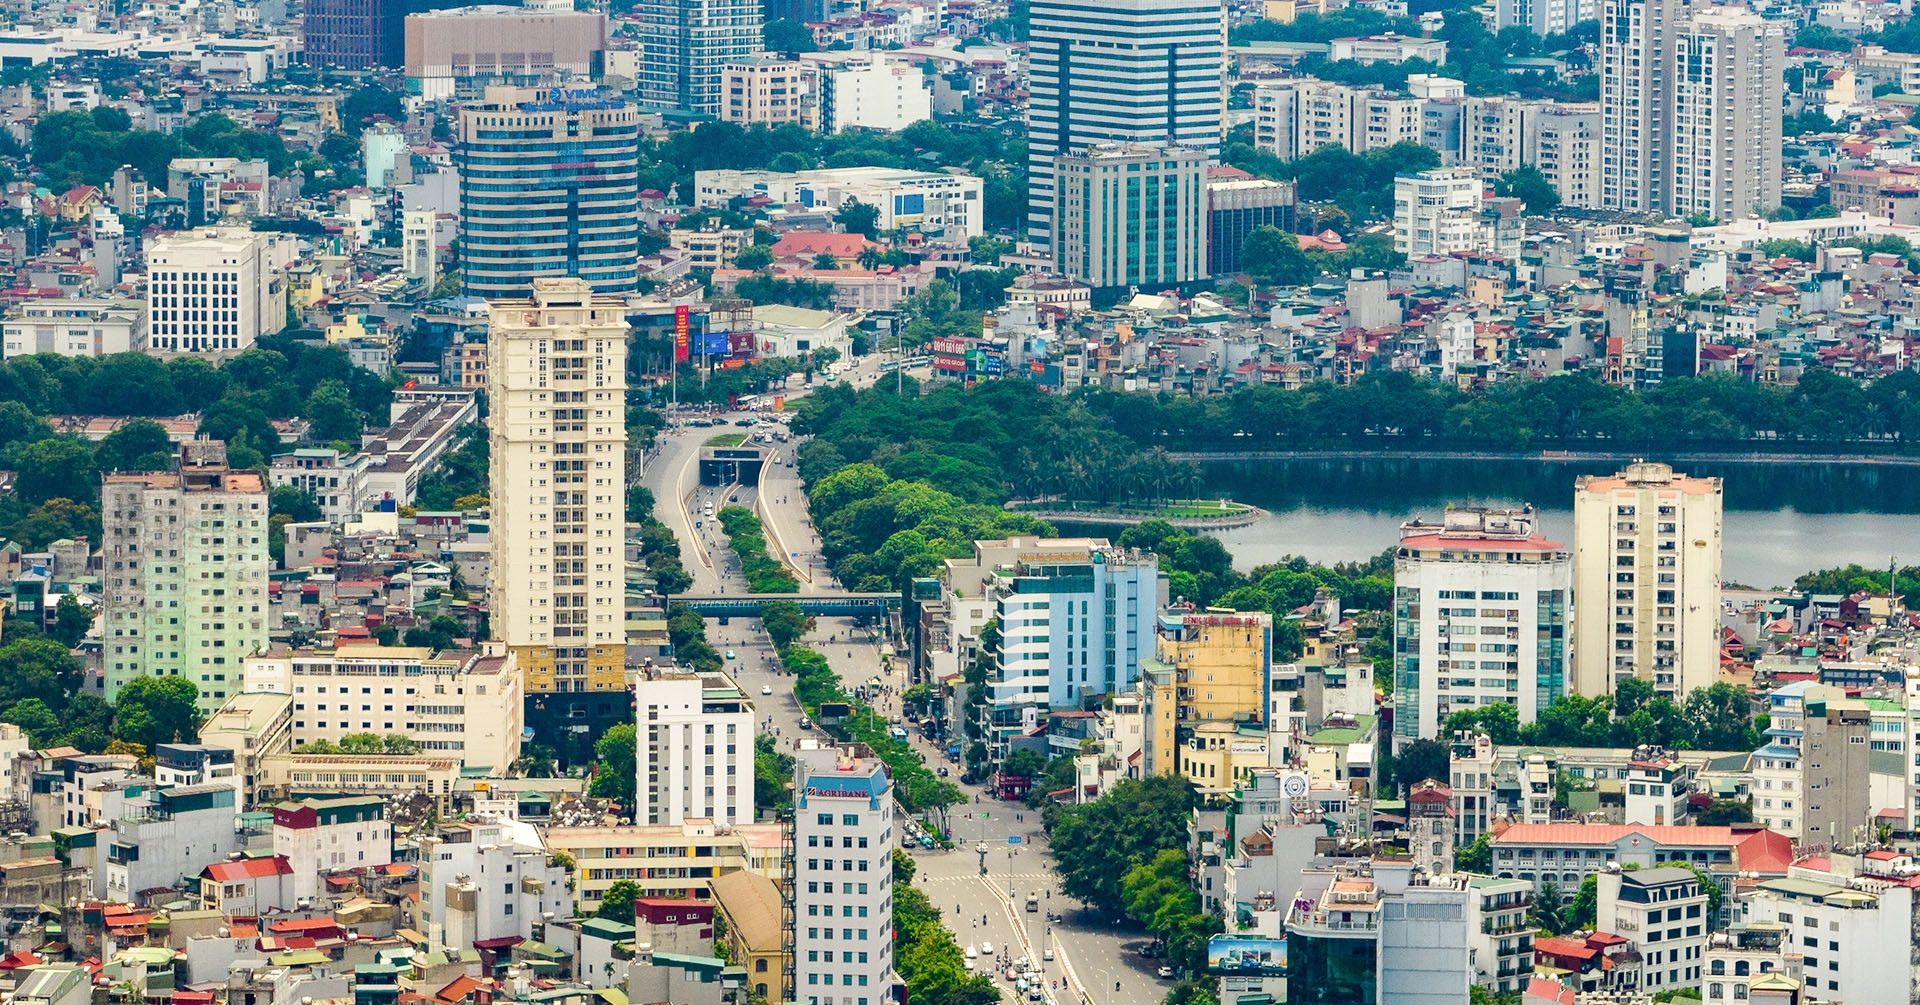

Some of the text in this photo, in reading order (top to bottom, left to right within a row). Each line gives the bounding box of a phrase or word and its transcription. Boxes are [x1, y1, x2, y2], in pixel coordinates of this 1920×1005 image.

[565, 89, 600, 99] VIMC
[557, 124, 591, 132] SIEMENS
[934, 340, 946, 352] 0911
[951, 359, 966, 367] GROUP
[818, 790, 869, 798] AGRIBANK
